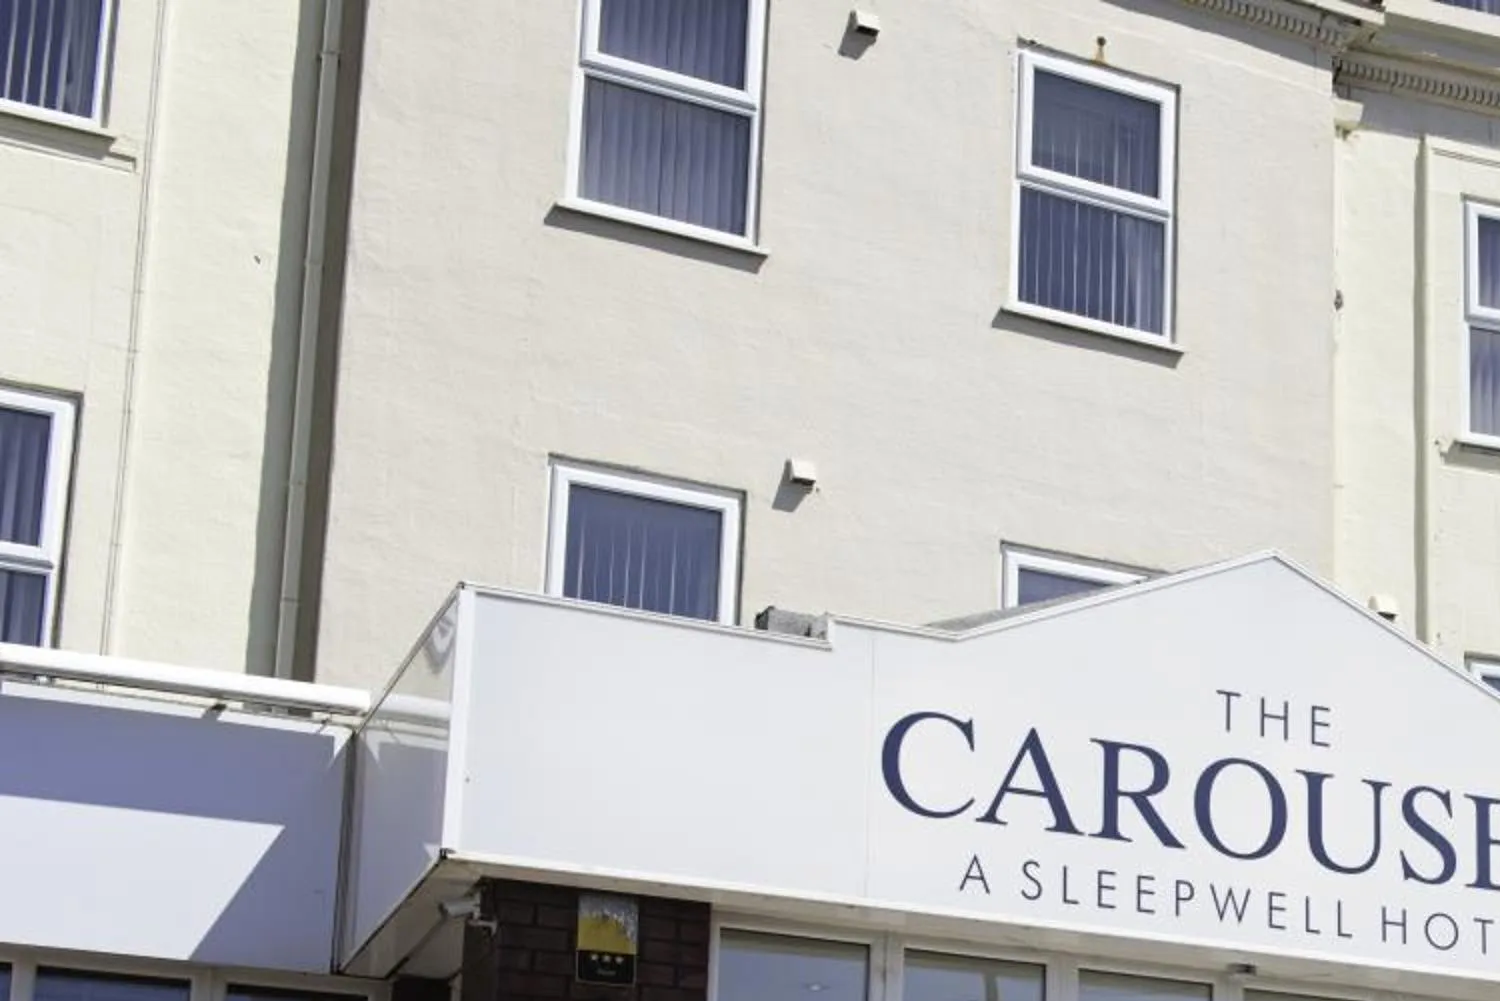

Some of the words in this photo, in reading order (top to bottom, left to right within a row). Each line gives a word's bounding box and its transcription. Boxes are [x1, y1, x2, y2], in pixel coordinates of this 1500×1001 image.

[1215, 689, 1332, 748] THE
[959, 854, 991, 895] A
[1020, 859, 1354, 939] SLEEPWELL
